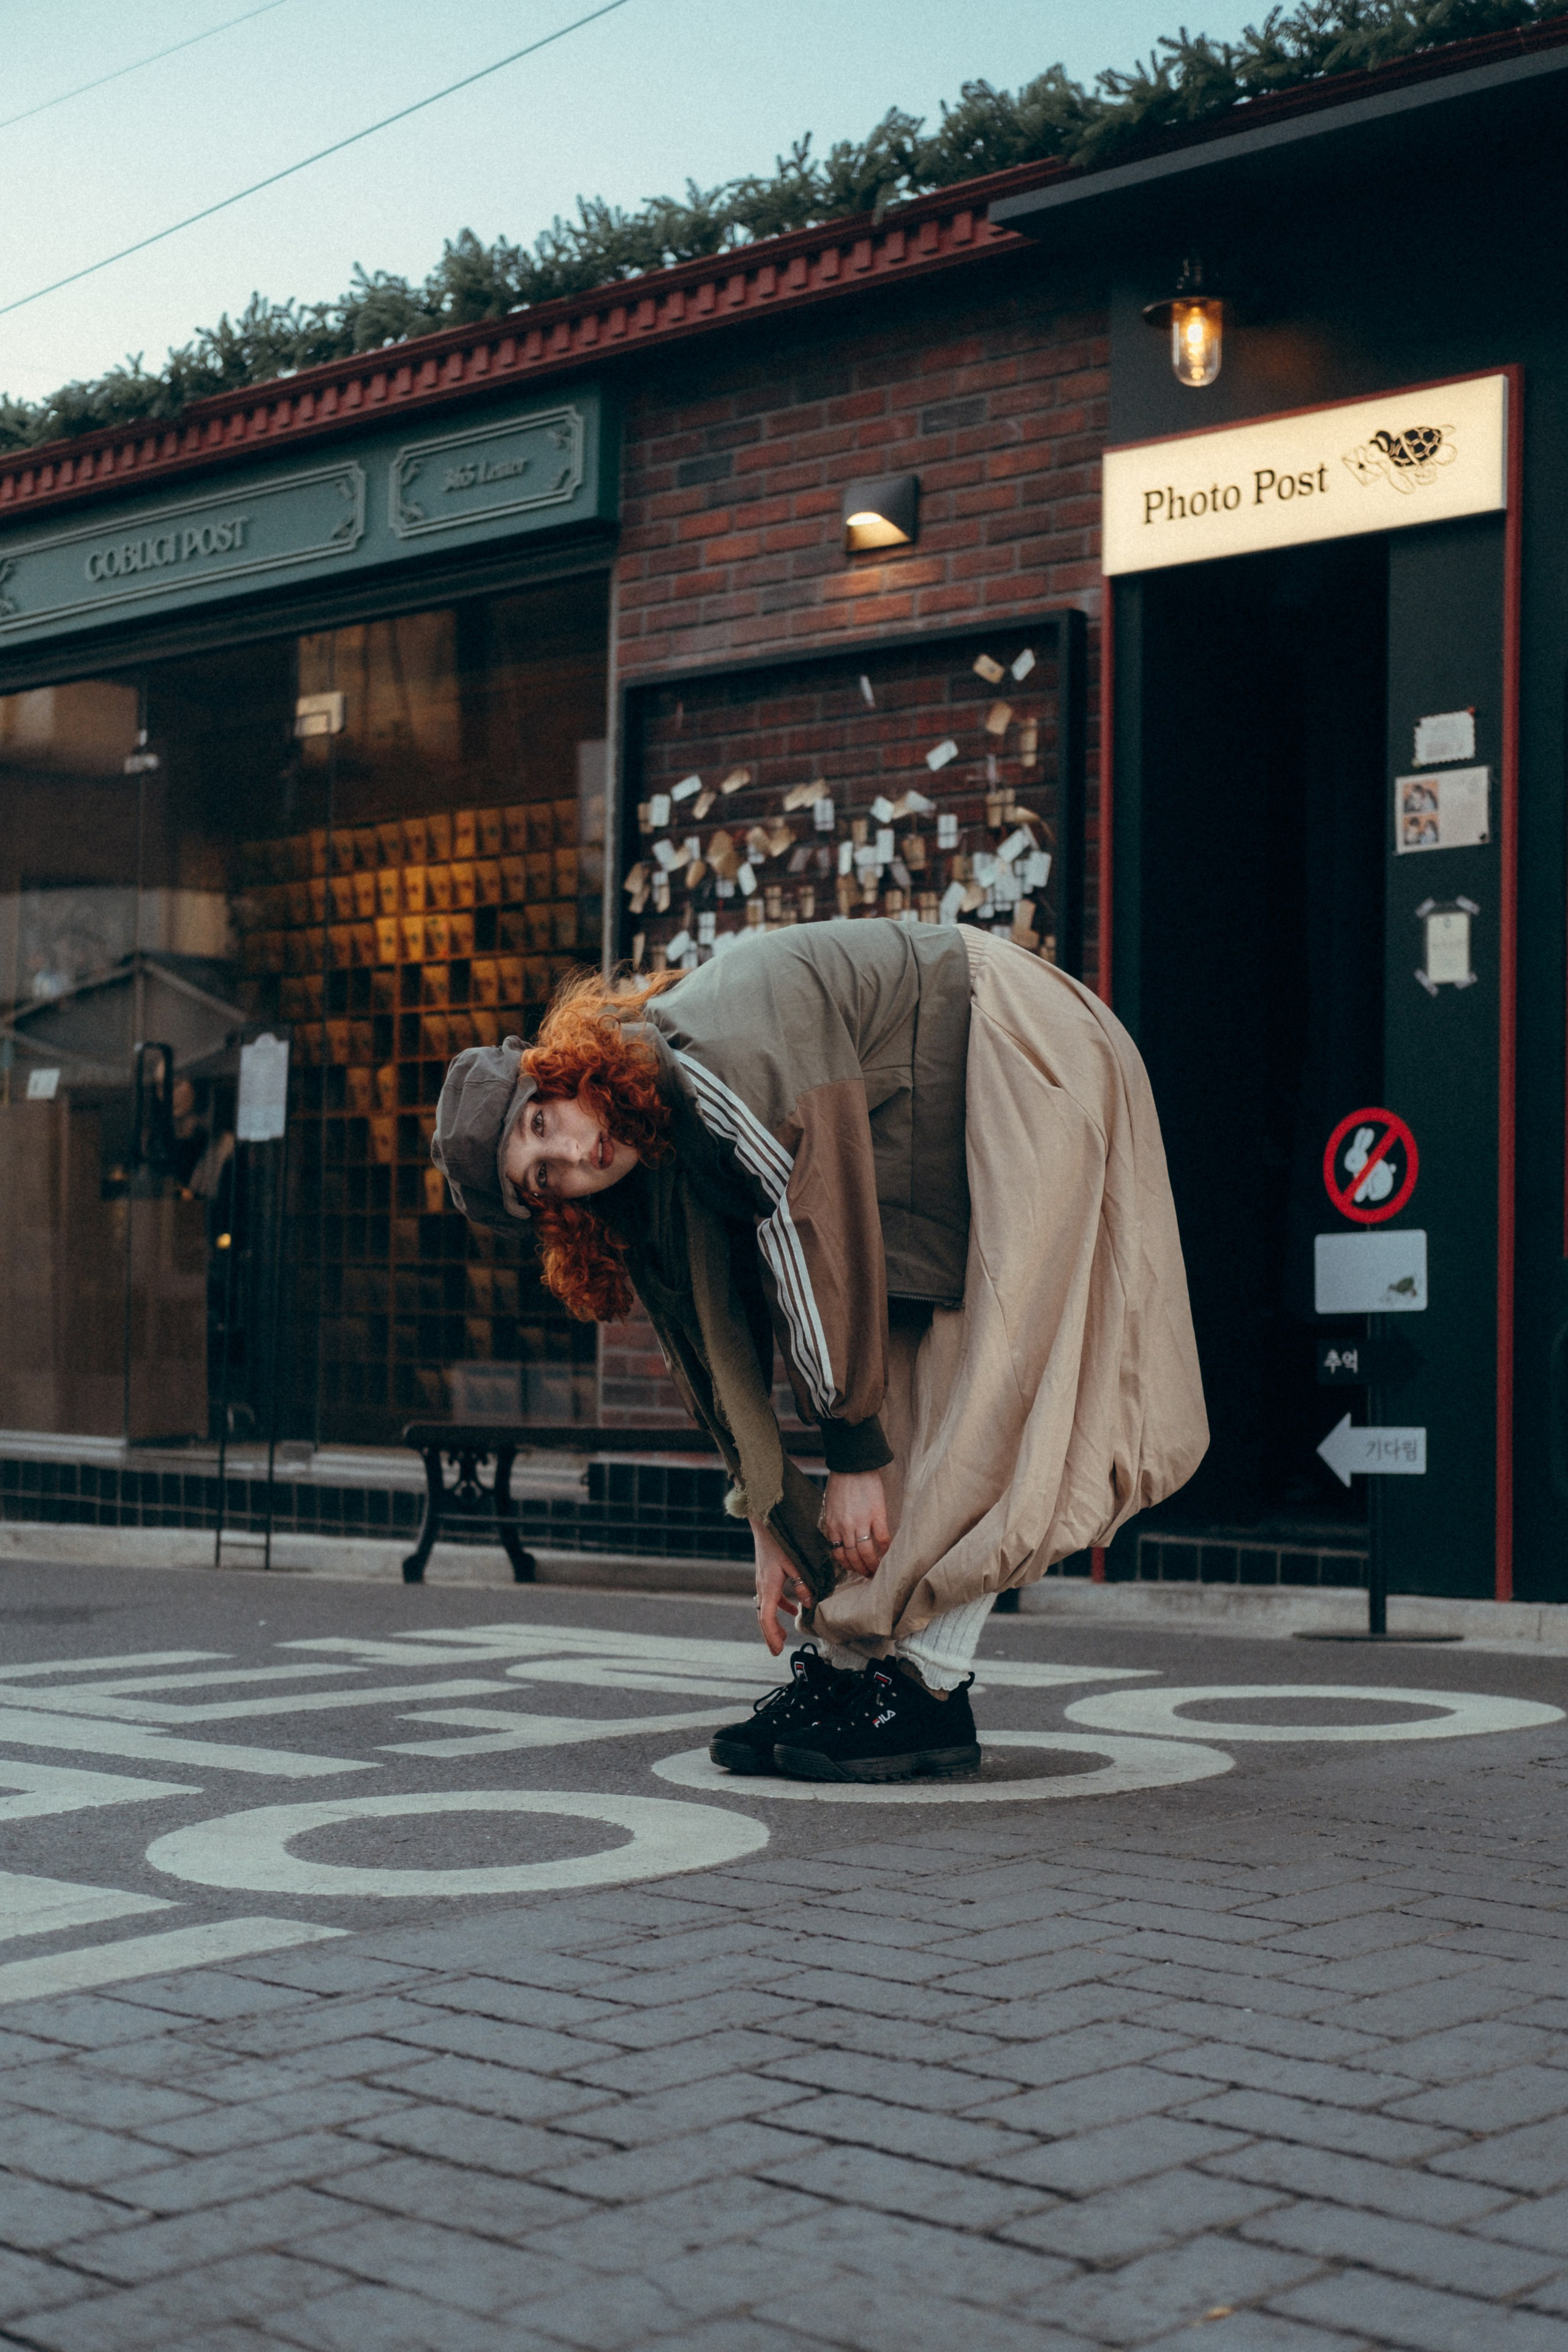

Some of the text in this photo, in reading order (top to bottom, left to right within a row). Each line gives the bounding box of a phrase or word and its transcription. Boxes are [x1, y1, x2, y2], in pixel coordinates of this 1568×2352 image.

[1142, 463, 1329, 525] Photo Post
[181, 516, 249, 560] POST
[1365, 1437, 1418, 1463] 기다림
[872, 1709, 897, 1728] FILA
